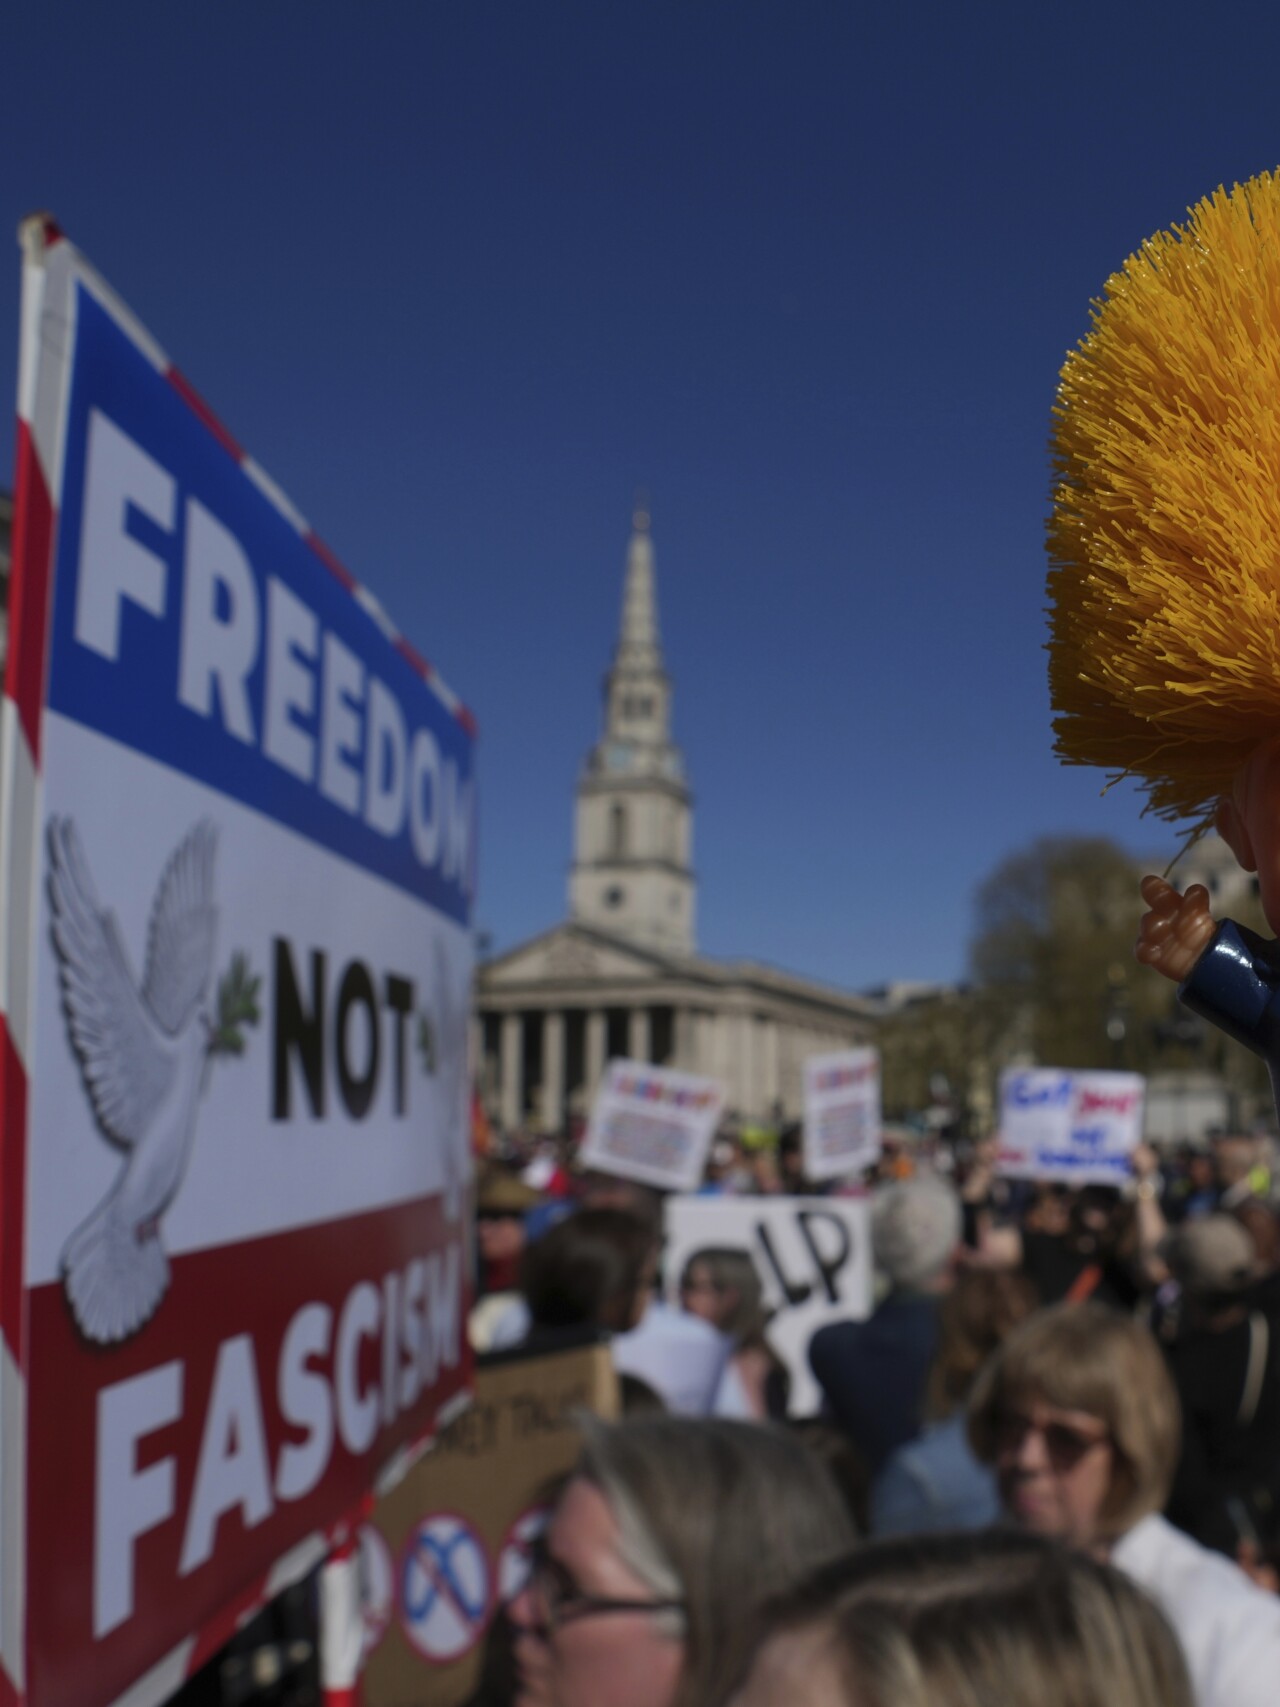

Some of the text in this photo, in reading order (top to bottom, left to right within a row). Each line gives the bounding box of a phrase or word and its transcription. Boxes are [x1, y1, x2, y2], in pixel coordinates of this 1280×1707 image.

[74, 406, 474, 893] FREEDOM
[272, 935, 414, 1121] NOT
[92, 1243, 461, 1641] FASCISM
